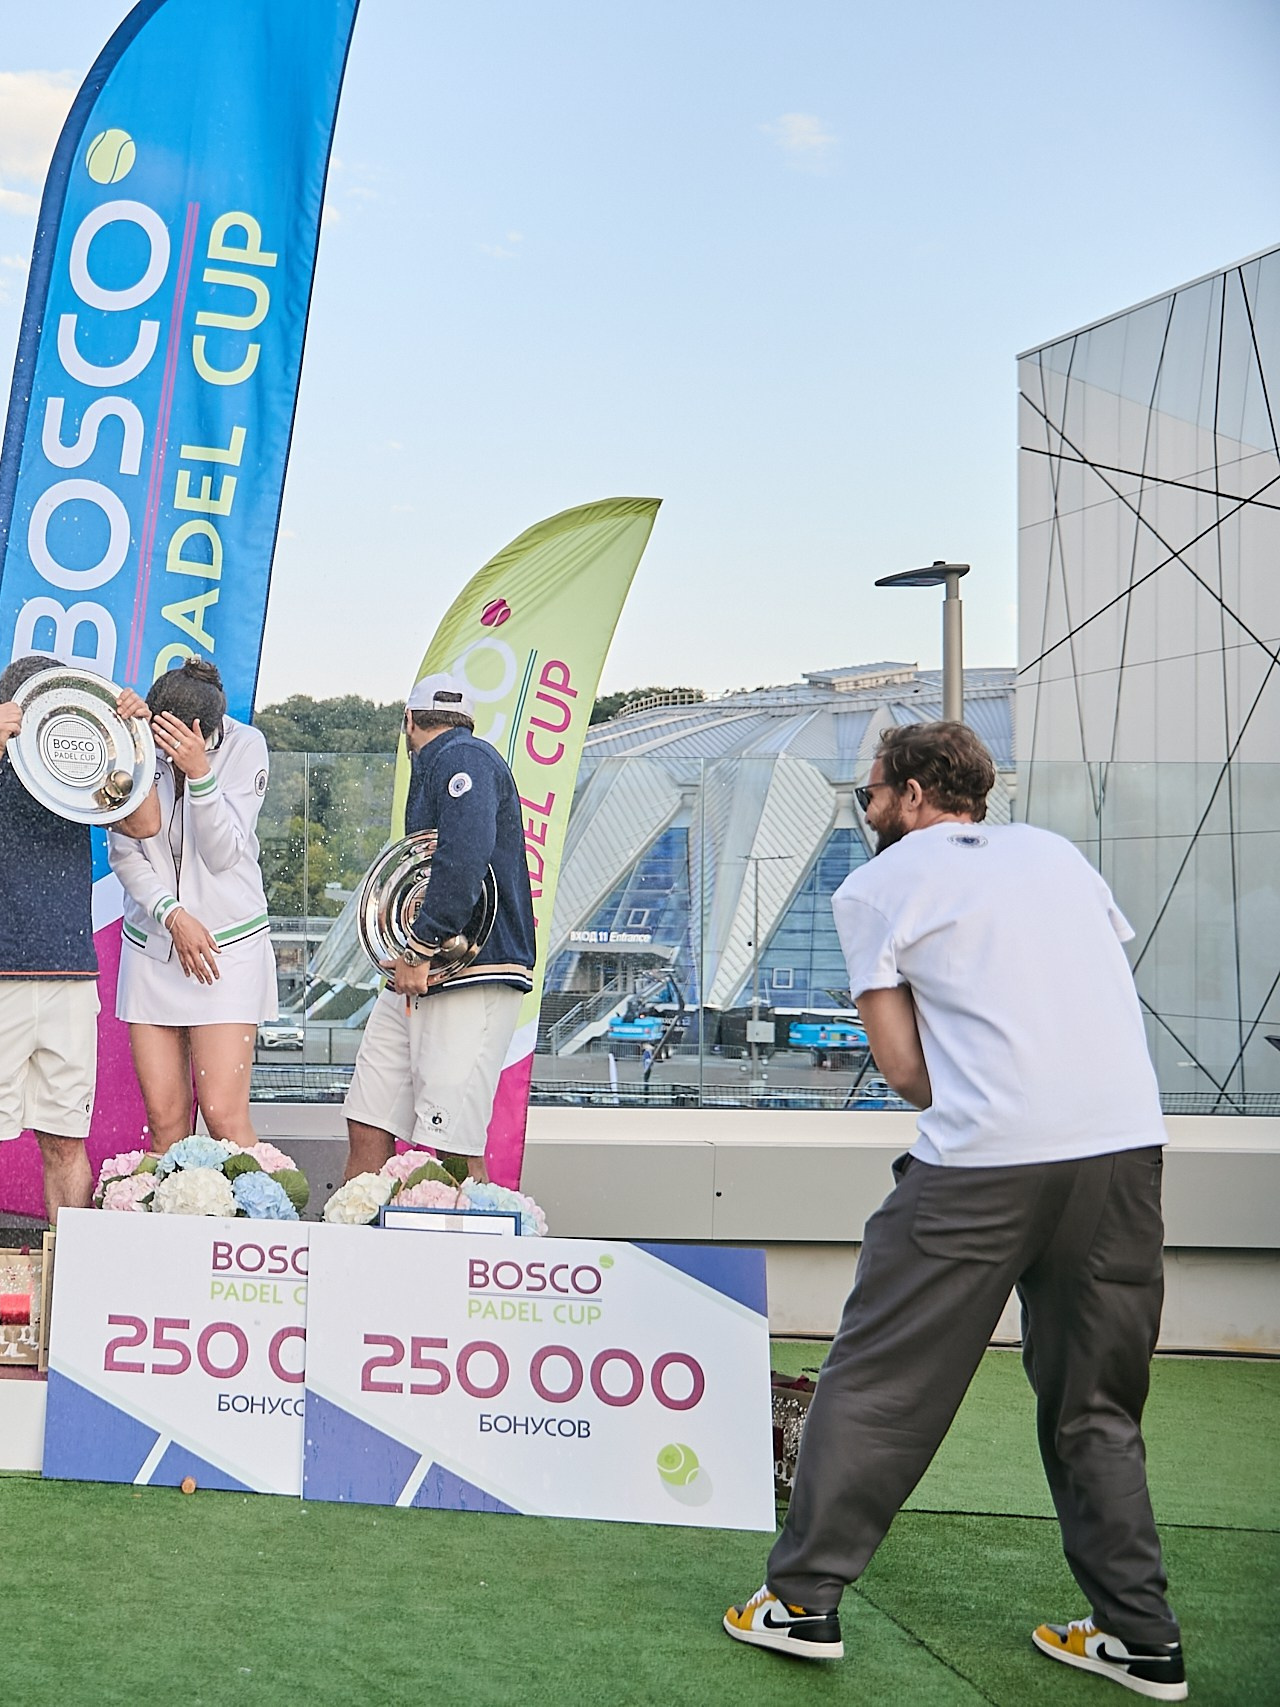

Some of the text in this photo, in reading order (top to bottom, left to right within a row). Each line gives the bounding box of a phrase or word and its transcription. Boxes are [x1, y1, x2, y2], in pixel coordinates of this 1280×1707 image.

[192, 210, 279, 386] CUP
[525, 659, 579, 766] CUP
[53, 738, 95, 752] BOSCO
[54, 751, 96, 761] PADEL CUP
[609, 931, 652, 943] Entrance
[468, 1257, 602, 1295] BOSCO
[210, 1280, 284, 1305] PADEL
[467, 1299, 602, 1326] PADEL CUP
[103, 1313, 250, 1380] 250
[361, 1333, 511, 1400] 250
[529, 1344, 706, 1412] 000
[479, 1413, 591, 1439] БОНУСОВ
